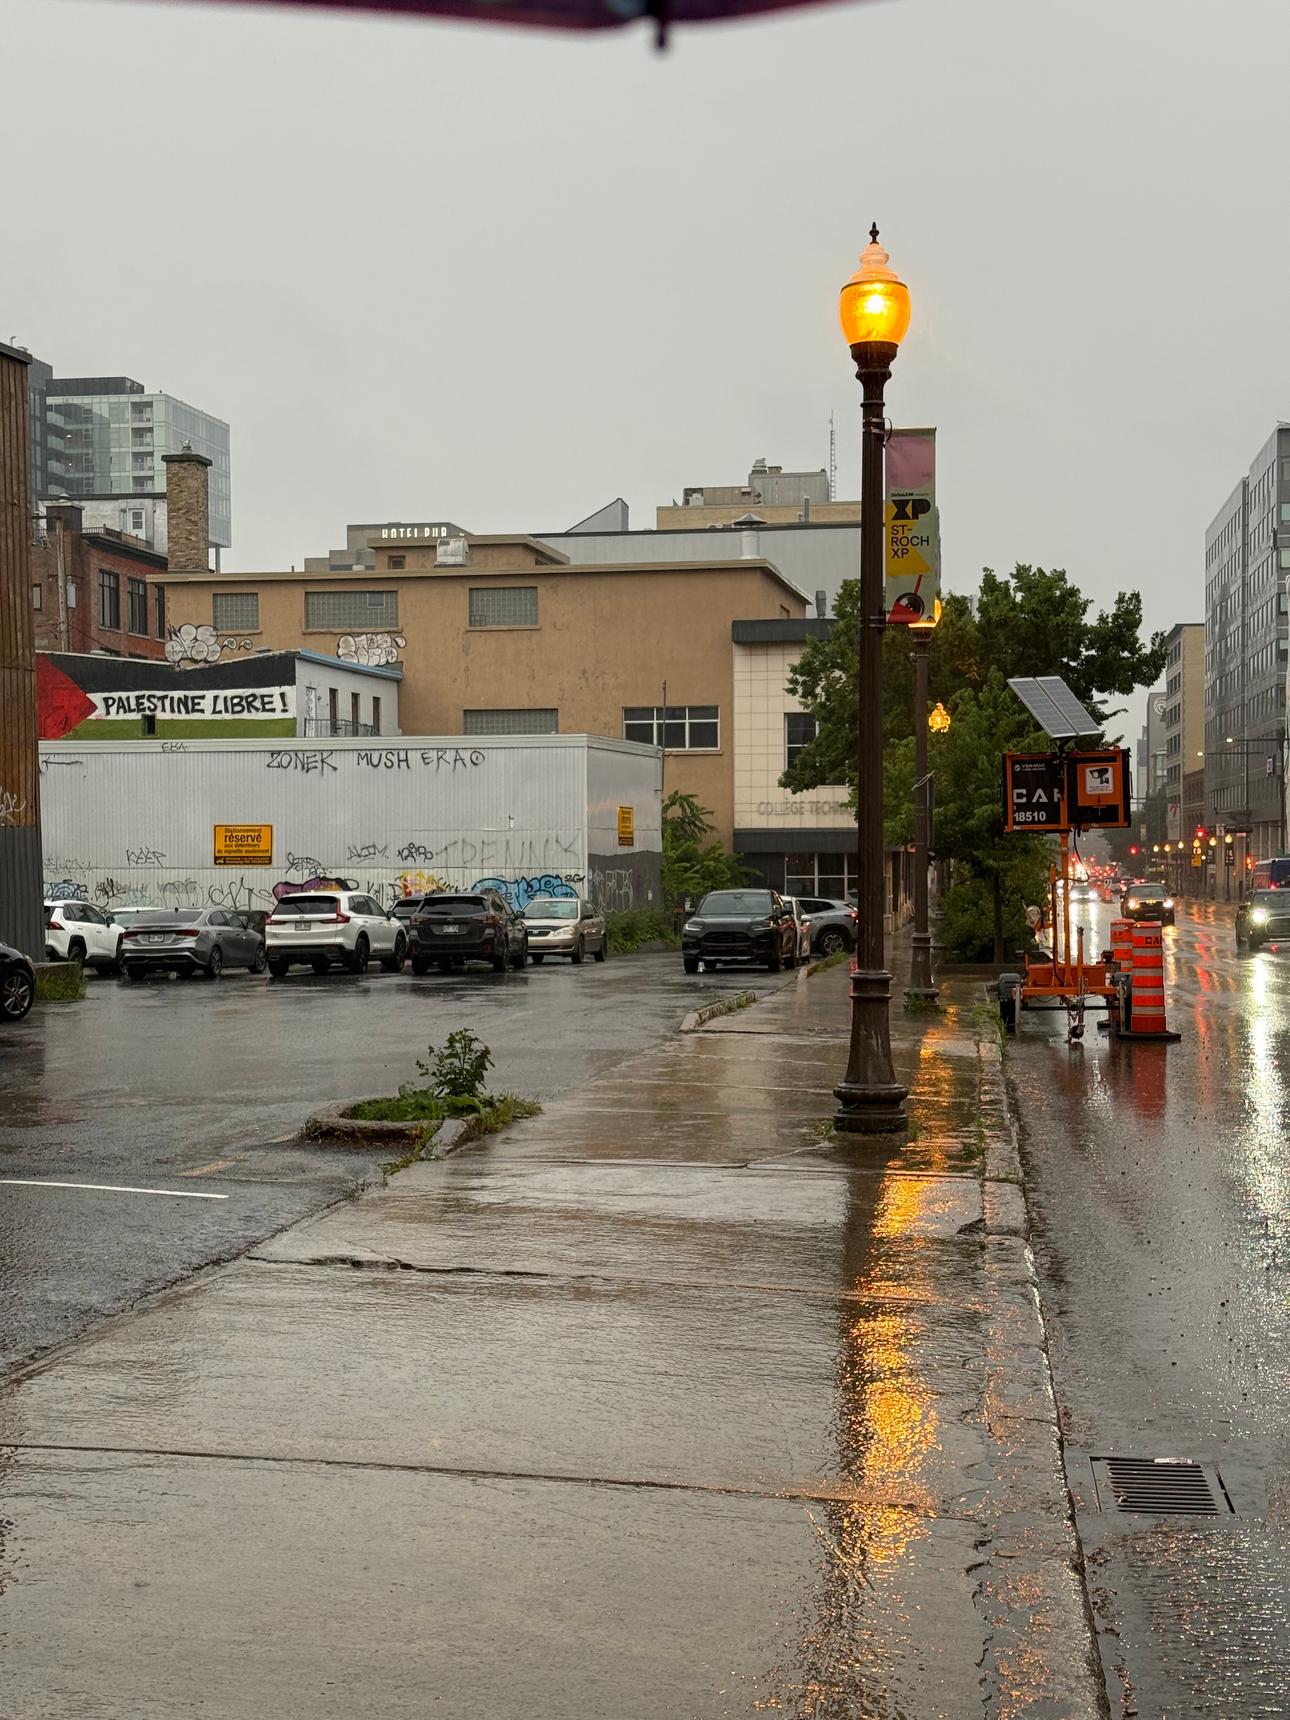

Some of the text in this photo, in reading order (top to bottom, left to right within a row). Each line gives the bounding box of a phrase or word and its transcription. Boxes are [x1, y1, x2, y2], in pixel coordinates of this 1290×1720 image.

[891, 499, 931, 520] XP
[891, 525, 912, 535] ST-
[891, 536, 929, 547] ROCH
[891, 548, 909, 559] XP
[103, 695, 205, 715] PALESTINE
[357, 750, 411, 769] MUSH
[1013, 811, 1046, 821] 18510
[224, 833, 262, 842] réservé
